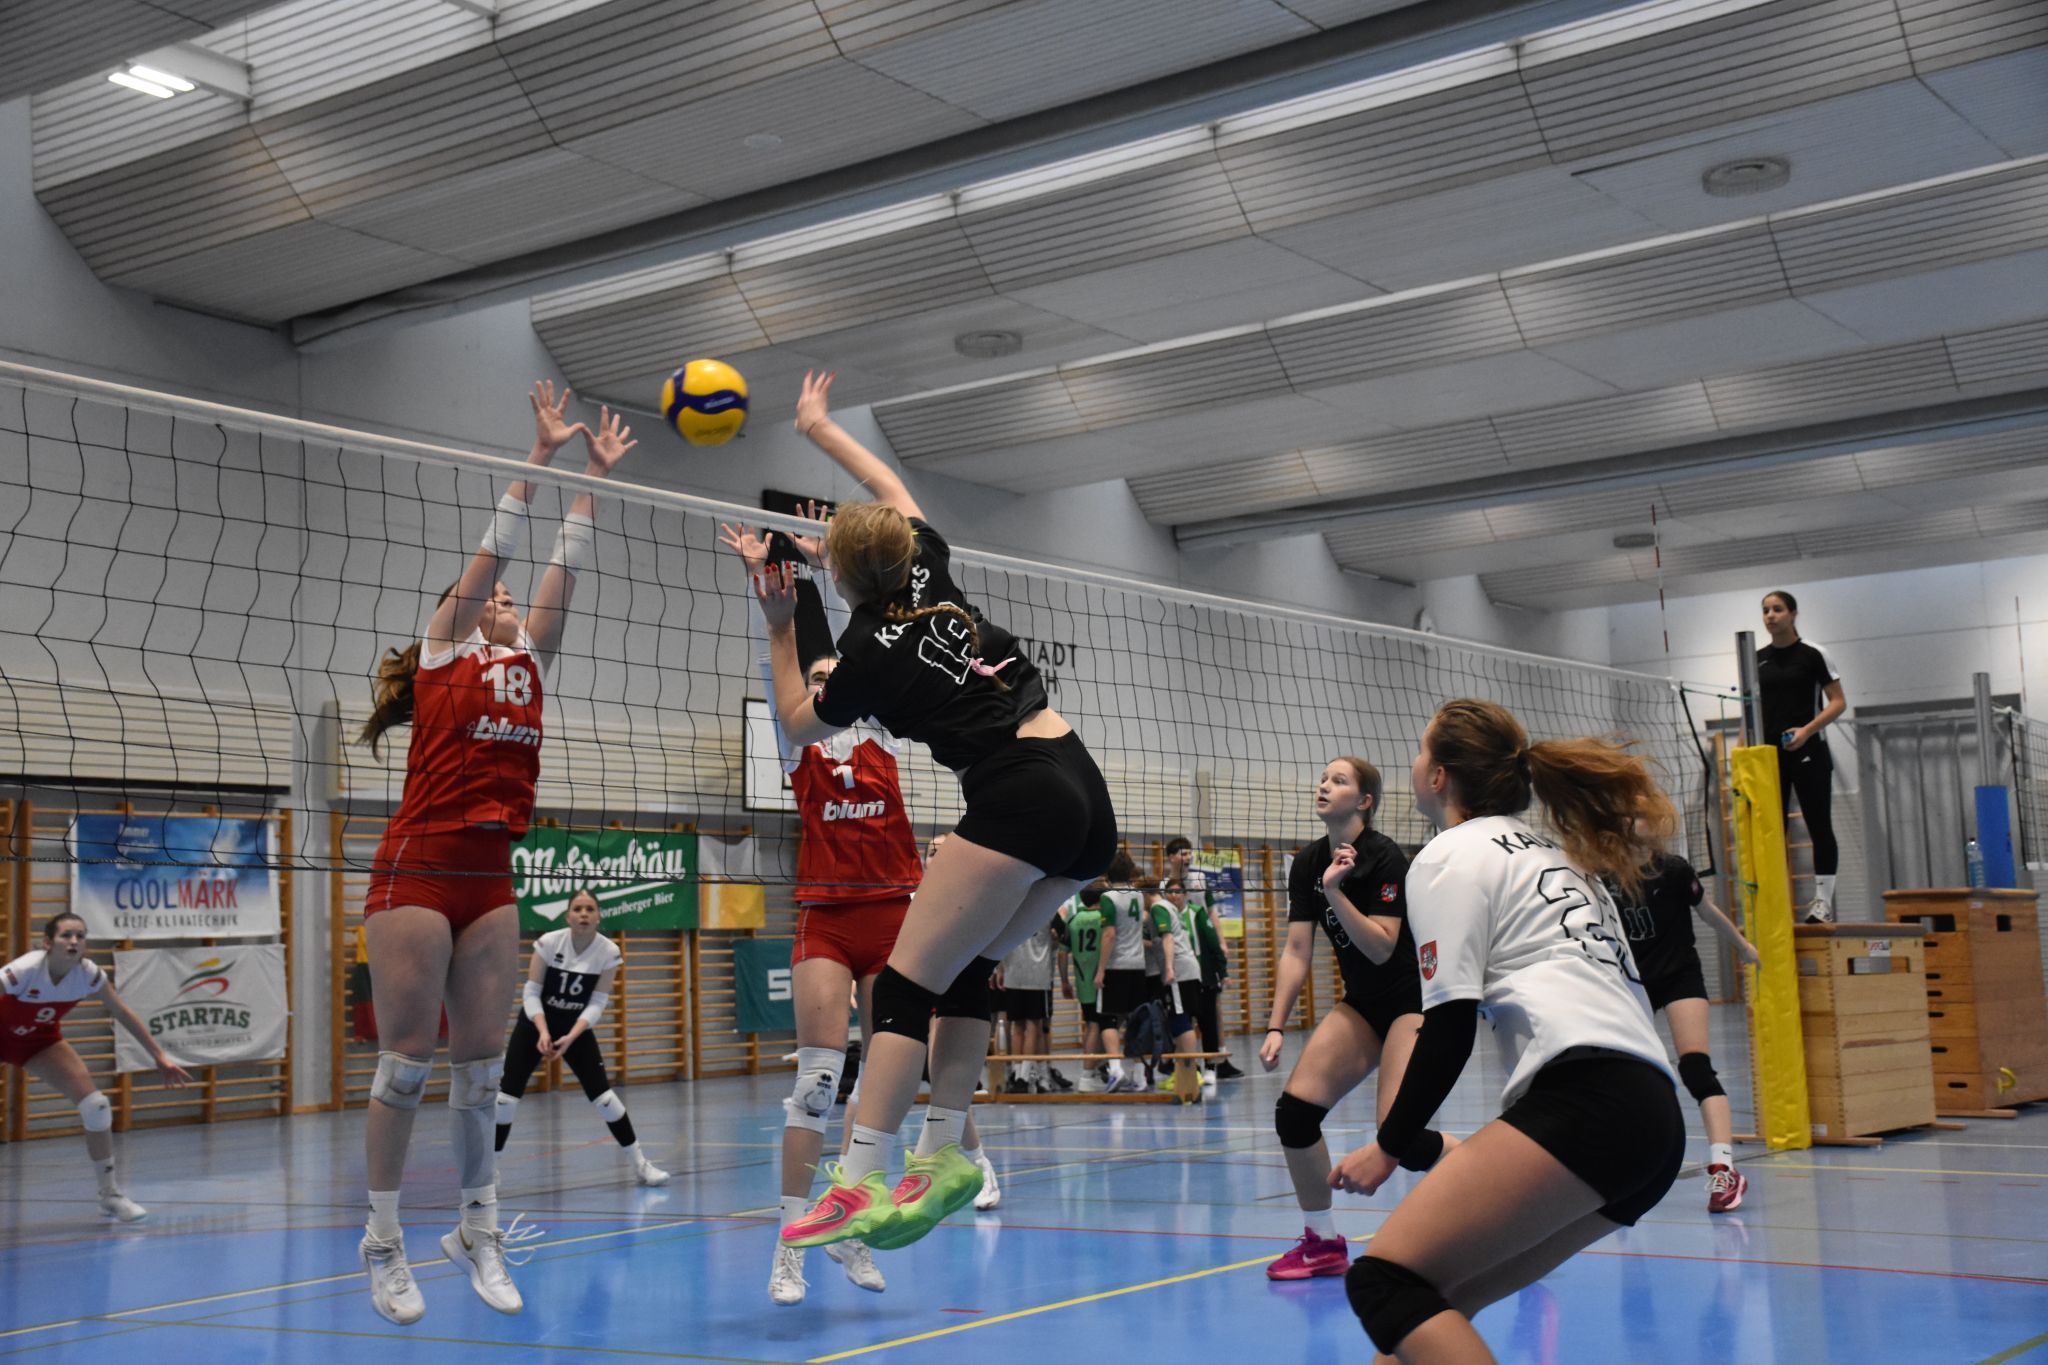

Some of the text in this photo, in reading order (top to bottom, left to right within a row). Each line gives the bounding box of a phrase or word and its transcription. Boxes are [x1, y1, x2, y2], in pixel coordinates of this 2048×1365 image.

[1024, 637, 1077, 668] TADT
[481, 663, 533, 707] 18
[473, 715, 540, 746] blum
[832, 765, 855, 789] 1
[823, 799, 885, 821] blum
[1490, 832, 1558, 855] KAU
[512, 838, 686, 898] Mohrenbräu
[600, 892, 675, 918] orarlberger Bier
[1128, 898, 1140, 922] 4
[1624, 906, 1656, 941] 11
[1078, 928, 1097, 953] 12
[560, 972, 583, 996] 16
[547, 995, 585, 1010] blum
[34, 1007, 56, 1024] 9
[149, 1007, 251, 1036] STARTAS
